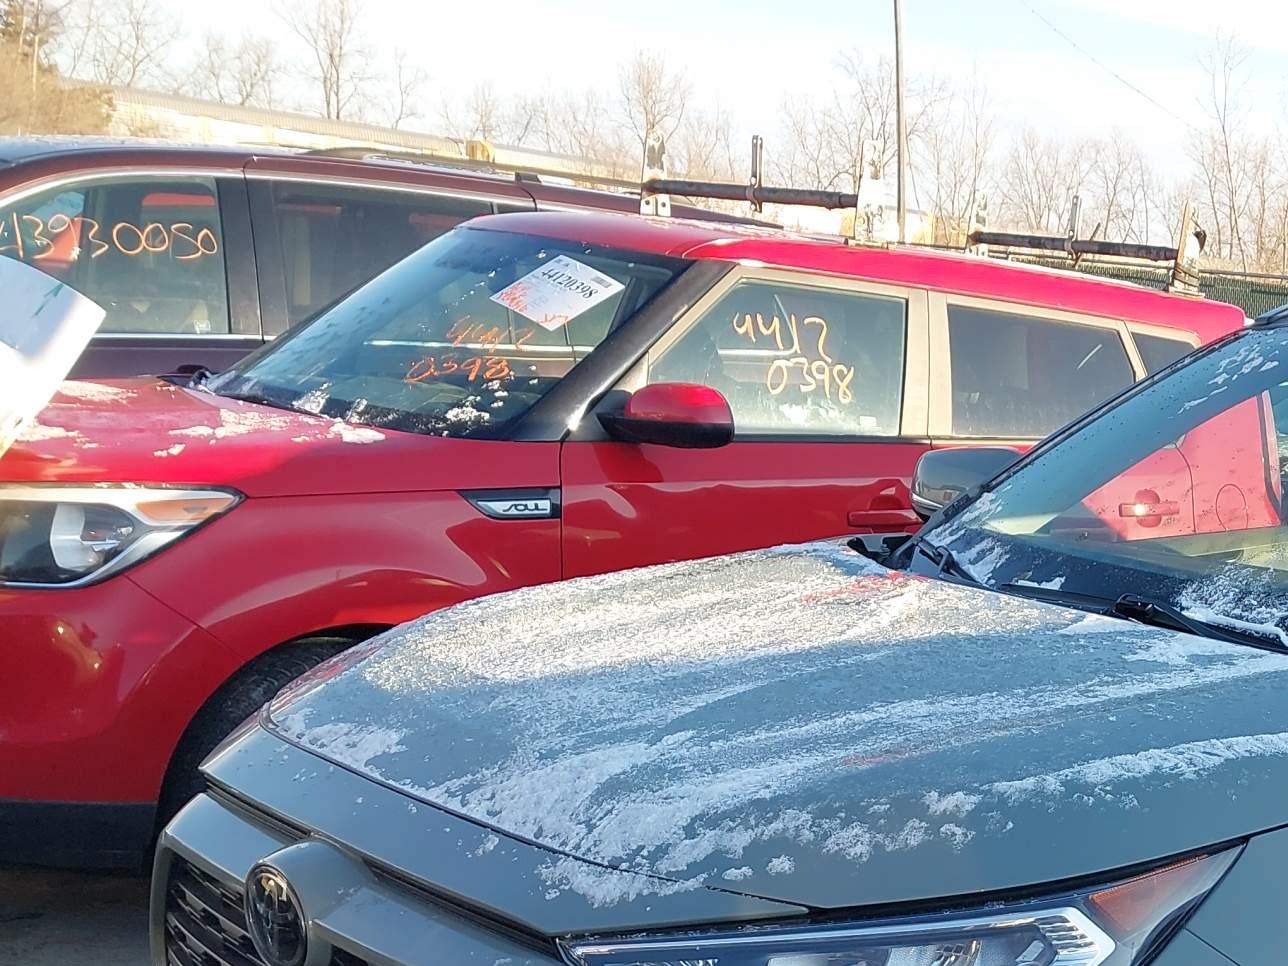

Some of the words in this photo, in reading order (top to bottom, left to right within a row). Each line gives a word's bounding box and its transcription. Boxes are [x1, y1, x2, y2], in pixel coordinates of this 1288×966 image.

[541, 268, 599, 299] 44120398
[732, 312, 833, 364] 4412
[404, 355, 511, 383] 0398
[766, 356, 855, 405] 0398
